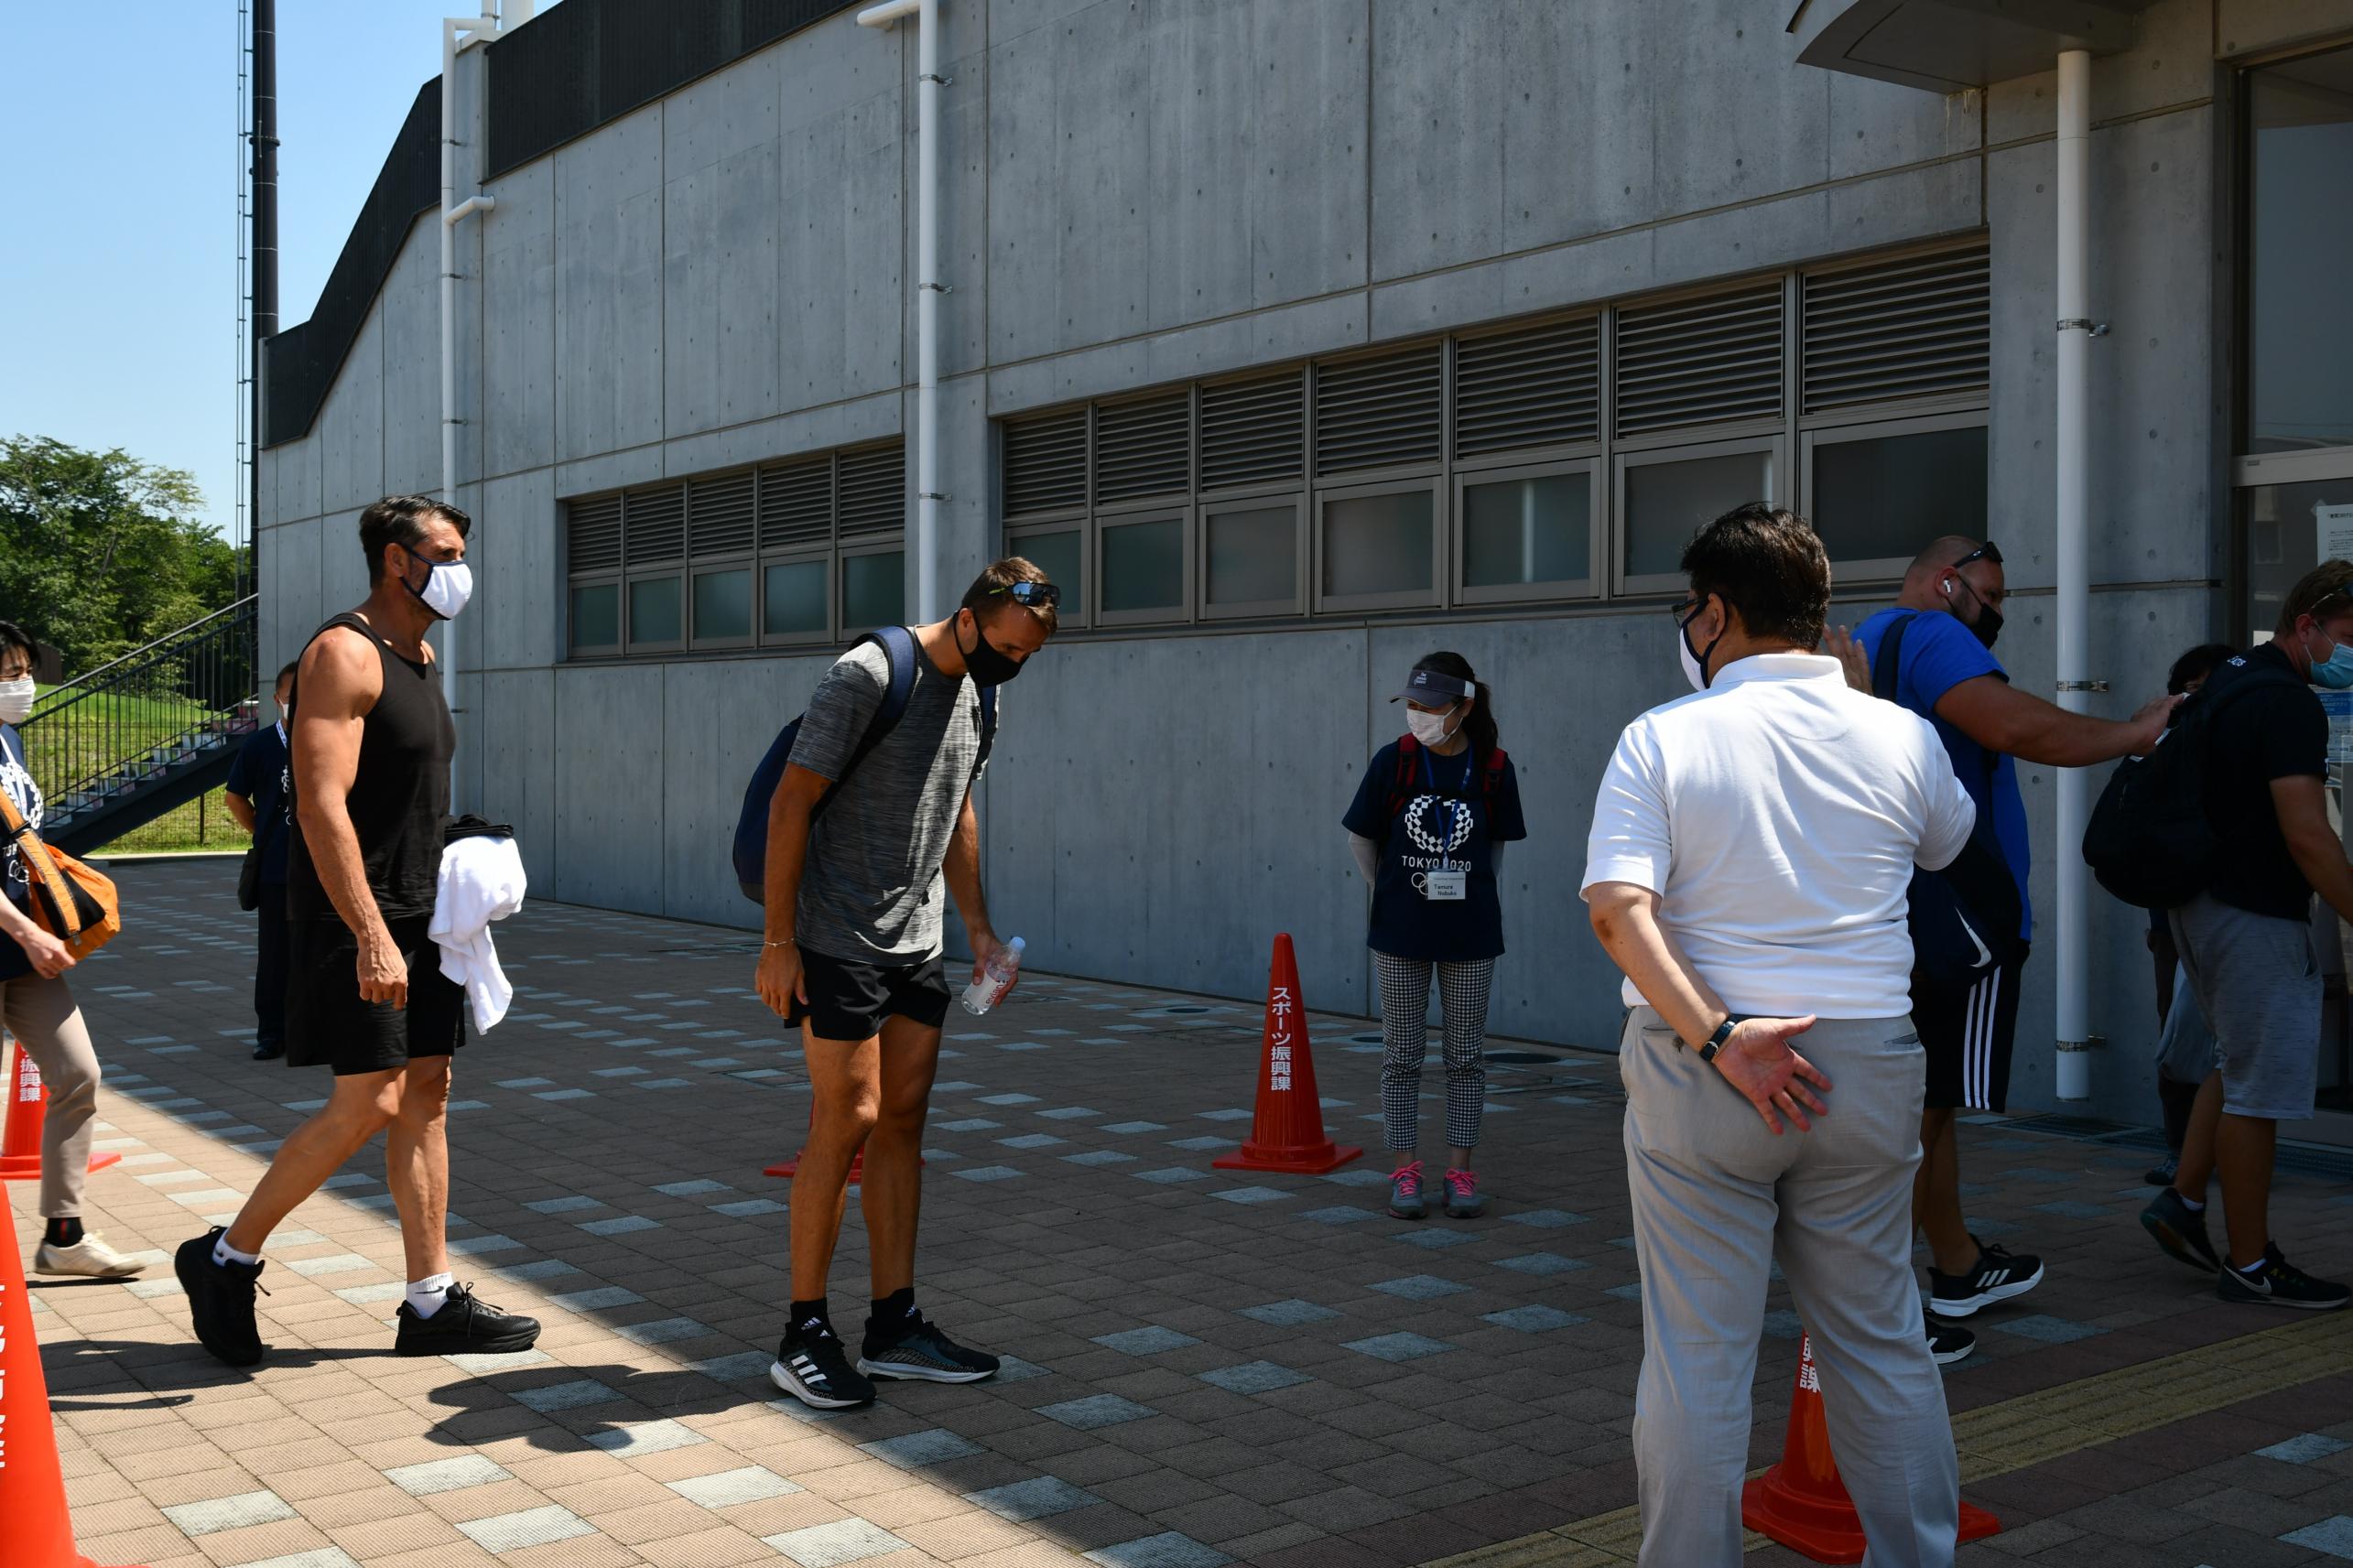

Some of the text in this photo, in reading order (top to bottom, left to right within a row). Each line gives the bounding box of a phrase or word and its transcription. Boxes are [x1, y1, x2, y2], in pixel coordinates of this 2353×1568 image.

[1401, 855, 1471, 871] TOKYO 020
[1271, 987, 1291, 1091] スポーツ振興課
[19, 1052, 42, 1102] 振興課
